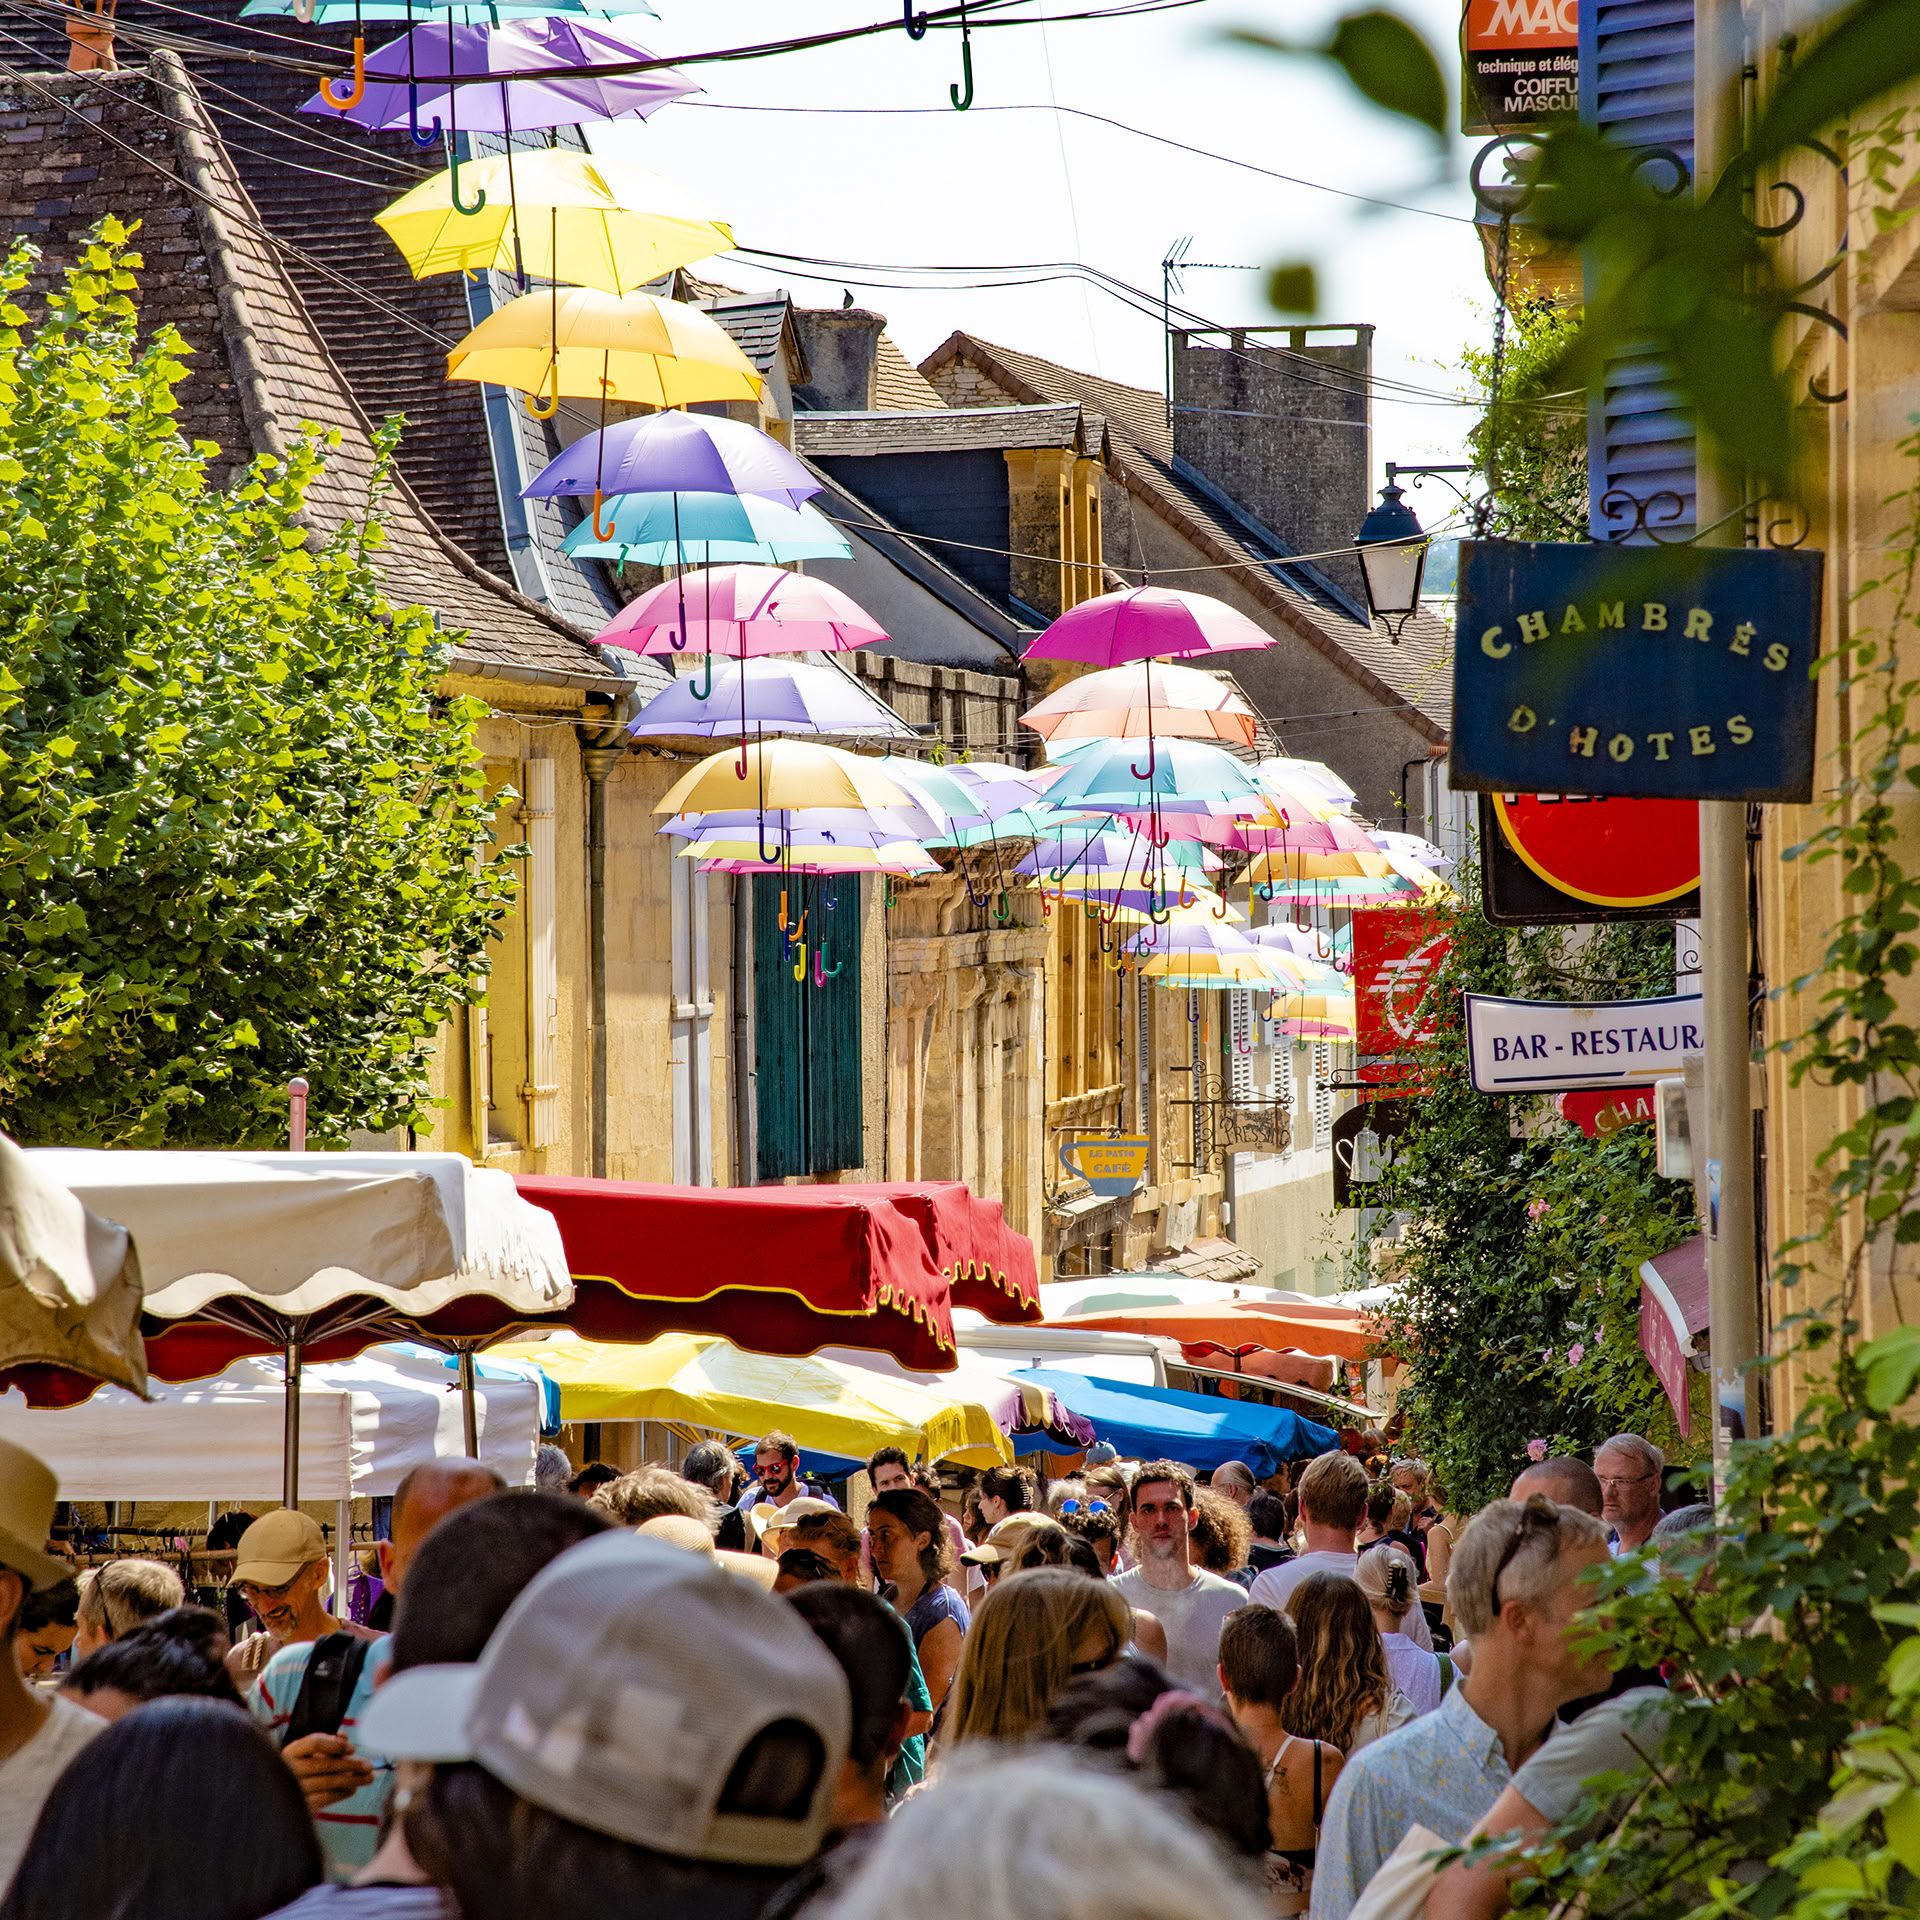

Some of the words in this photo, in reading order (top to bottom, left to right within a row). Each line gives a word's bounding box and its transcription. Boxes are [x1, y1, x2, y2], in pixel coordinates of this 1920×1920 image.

[1477, 58, 1536, 75] technique
[1539, 58, 1551, 72] et
[1553, 55, 1579, 74] élég
[1514, 77, 1579, 95] COIFFU
[1493, 1025, 1704, 1062] BAR-RESTAUR
[1595, 1094, 1657, 1132] CHA
[1089, 1150, 1103, 1158] LE
[1106, 1150, 1136, 1158] PATIO
